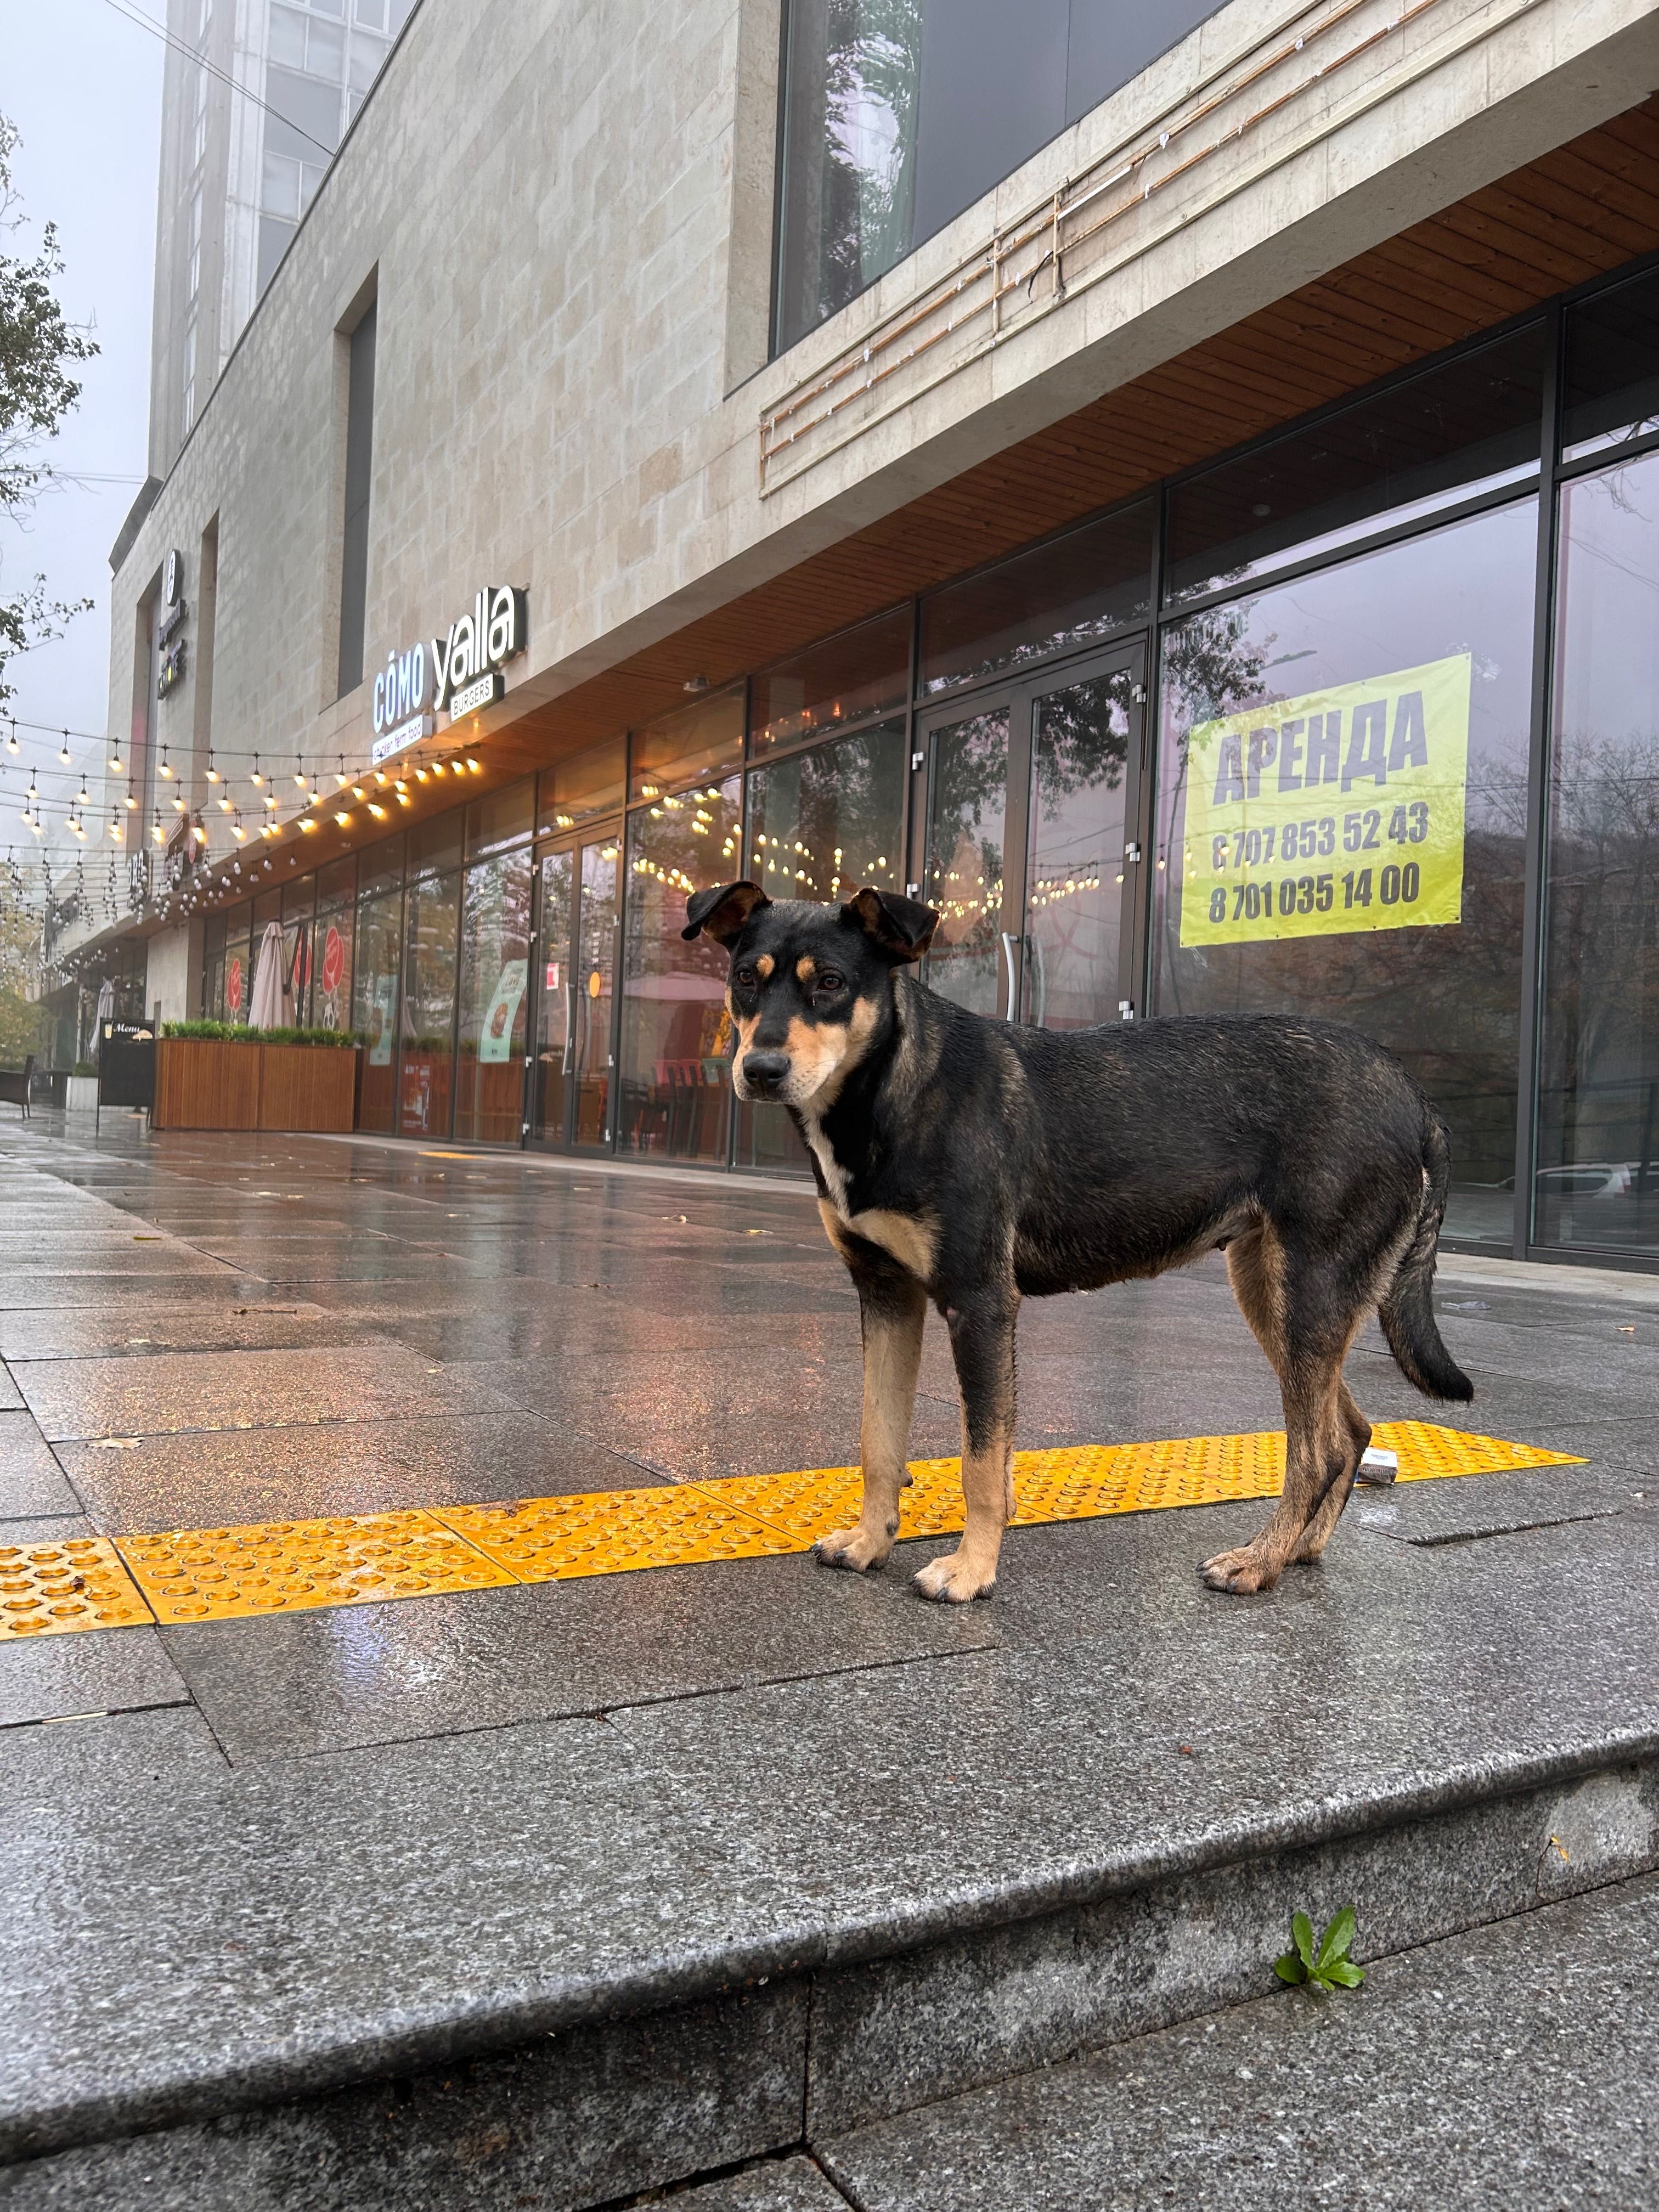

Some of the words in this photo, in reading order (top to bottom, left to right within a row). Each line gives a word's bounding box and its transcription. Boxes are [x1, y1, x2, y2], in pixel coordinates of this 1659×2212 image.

[431, 585, 515, 711] yalla
[454, 680, 489, 716] BURGERS
[408, 723, 421, 740] food
[1212, 690, 1428, 805] АРЕНДА
[1212, 835, 1227, 871] 8
[1233, 826, 1276, 868] 707
[1281, 816, 1335, 861] 853
[1343, 809, 1381, 852] 52
[1388, 802, 1429, 845] 43
[1209, 887, 1227, 923] 8
[1232, 881, 1272, 921] 701
[1279, 873, 1334, 916] 035
[1341, 868, 1373, 910] 14
[1380, 862, 1420, 905] 00
[113, 1023, 140, 1033] Menu
